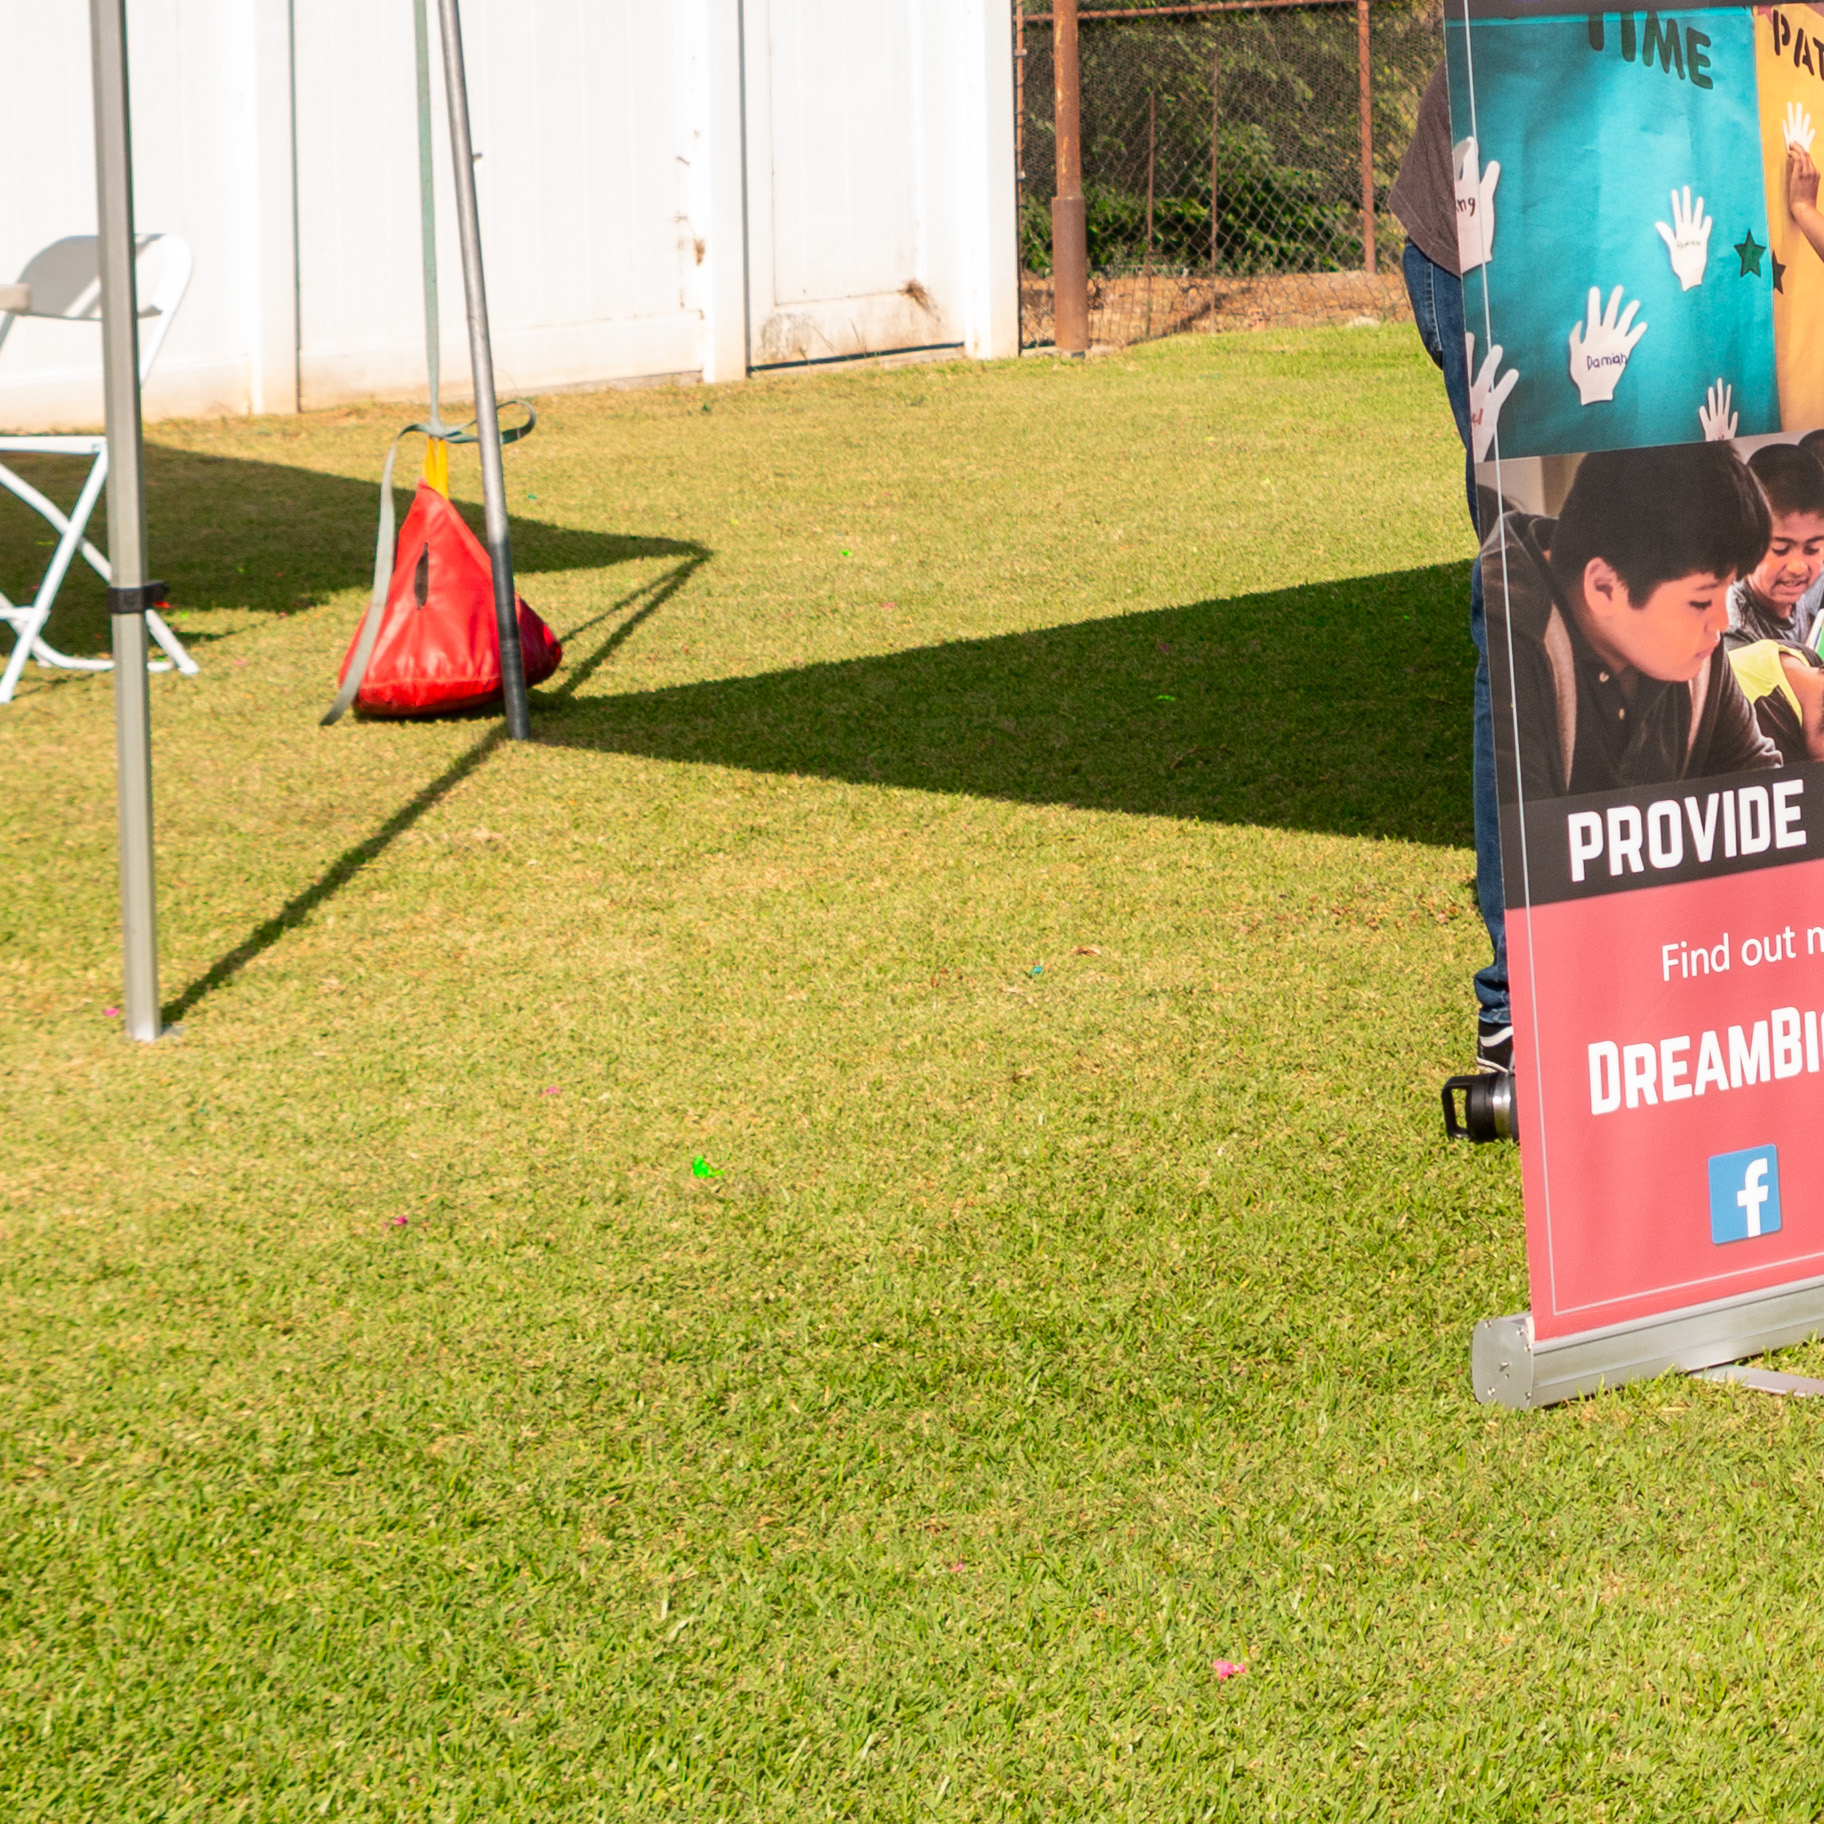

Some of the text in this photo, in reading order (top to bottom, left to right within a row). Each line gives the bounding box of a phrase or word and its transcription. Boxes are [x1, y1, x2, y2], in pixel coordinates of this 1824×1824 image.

[1567, 778, 1809, 883] PROVIDE
[1660, 938, 1732, 983] Find
[1740, 923, 1798, 967] out
